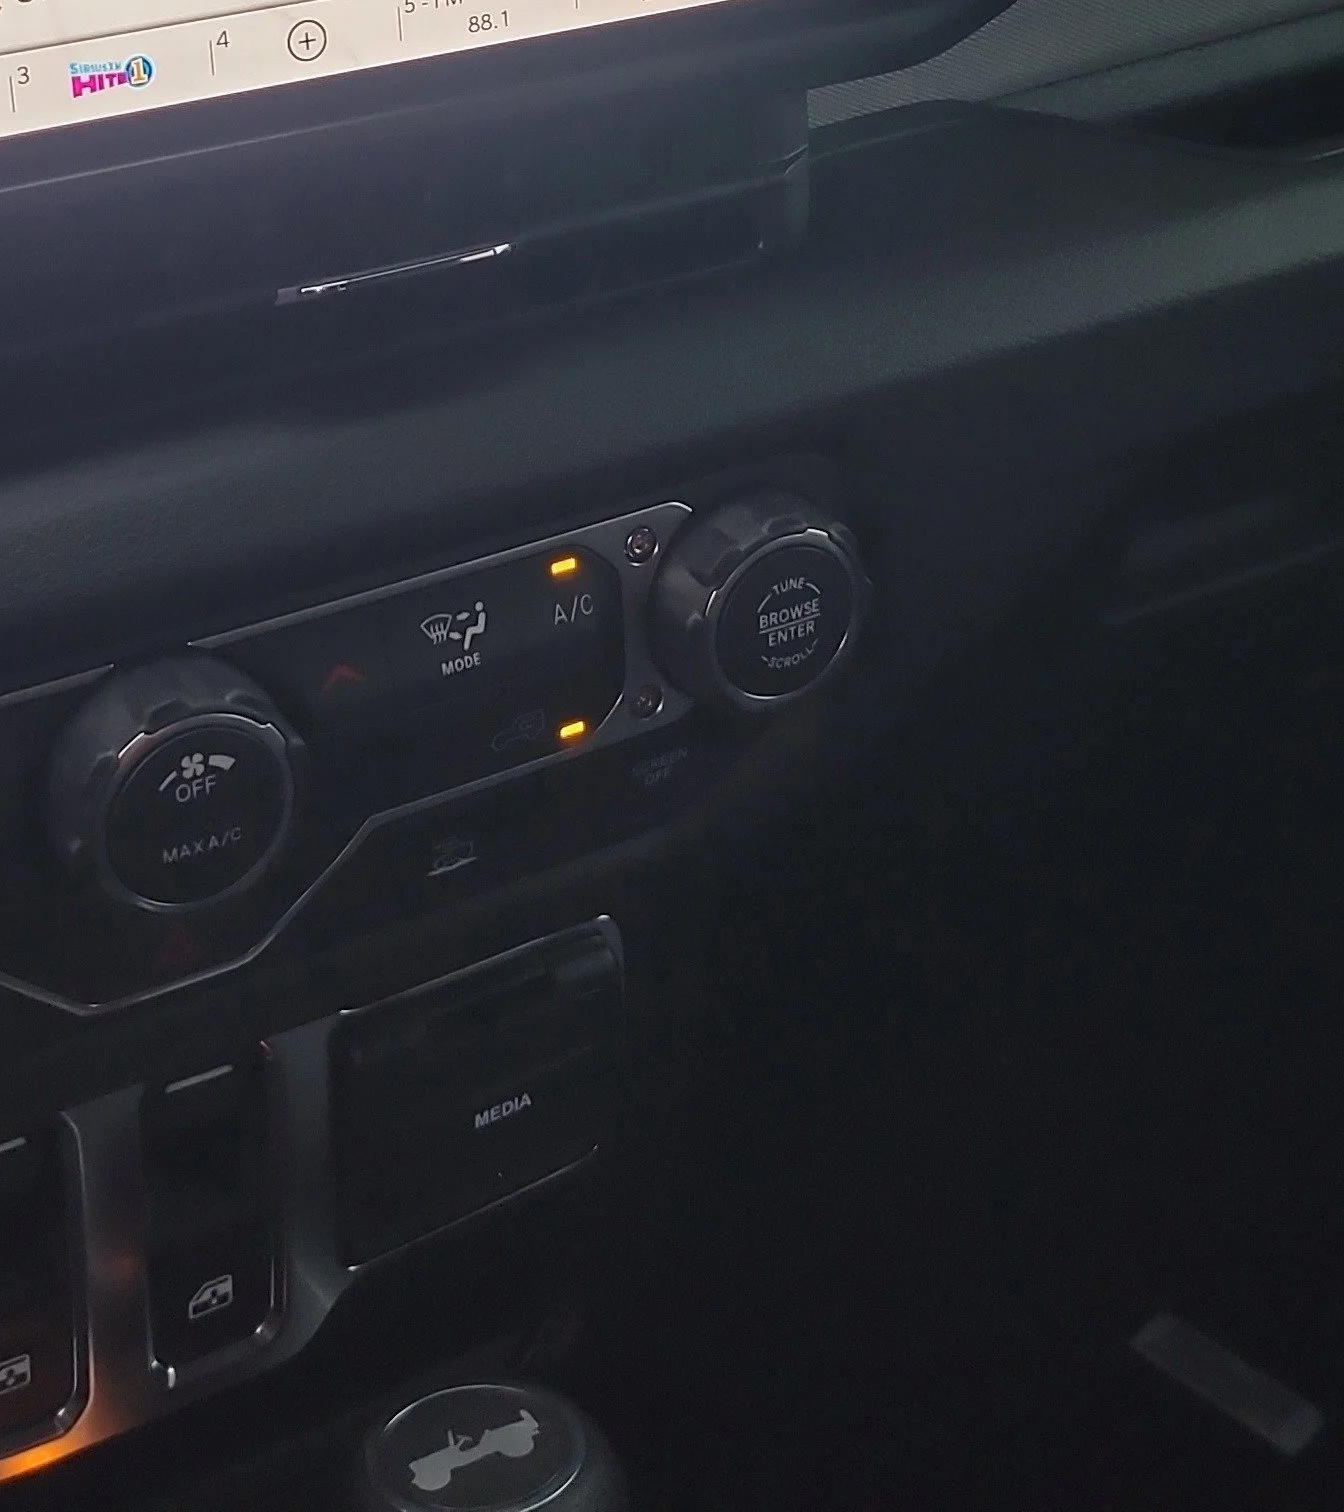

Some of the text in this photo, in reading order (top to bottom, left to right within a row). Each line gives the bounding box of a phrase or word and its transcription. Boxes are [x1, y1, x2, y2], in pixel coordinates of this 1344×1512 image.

[468, 9, 511, 35] 88.1
[215, 29, 231, 51] 4
[15, 65, 31, 86] 3
[772, 577, 806, 596] TUNE
[554, 592, 594, 626] A/C
[758, 598, 820, 630] BROWSE
[767, 620, 816, 647] ENTER
[441, 651, 482, 677] MODE
[174, 774, 217, 803] OFF
[161, 824, 243, 866] MAX A/C
[474, 1092, 532, 1128] MEDIA
